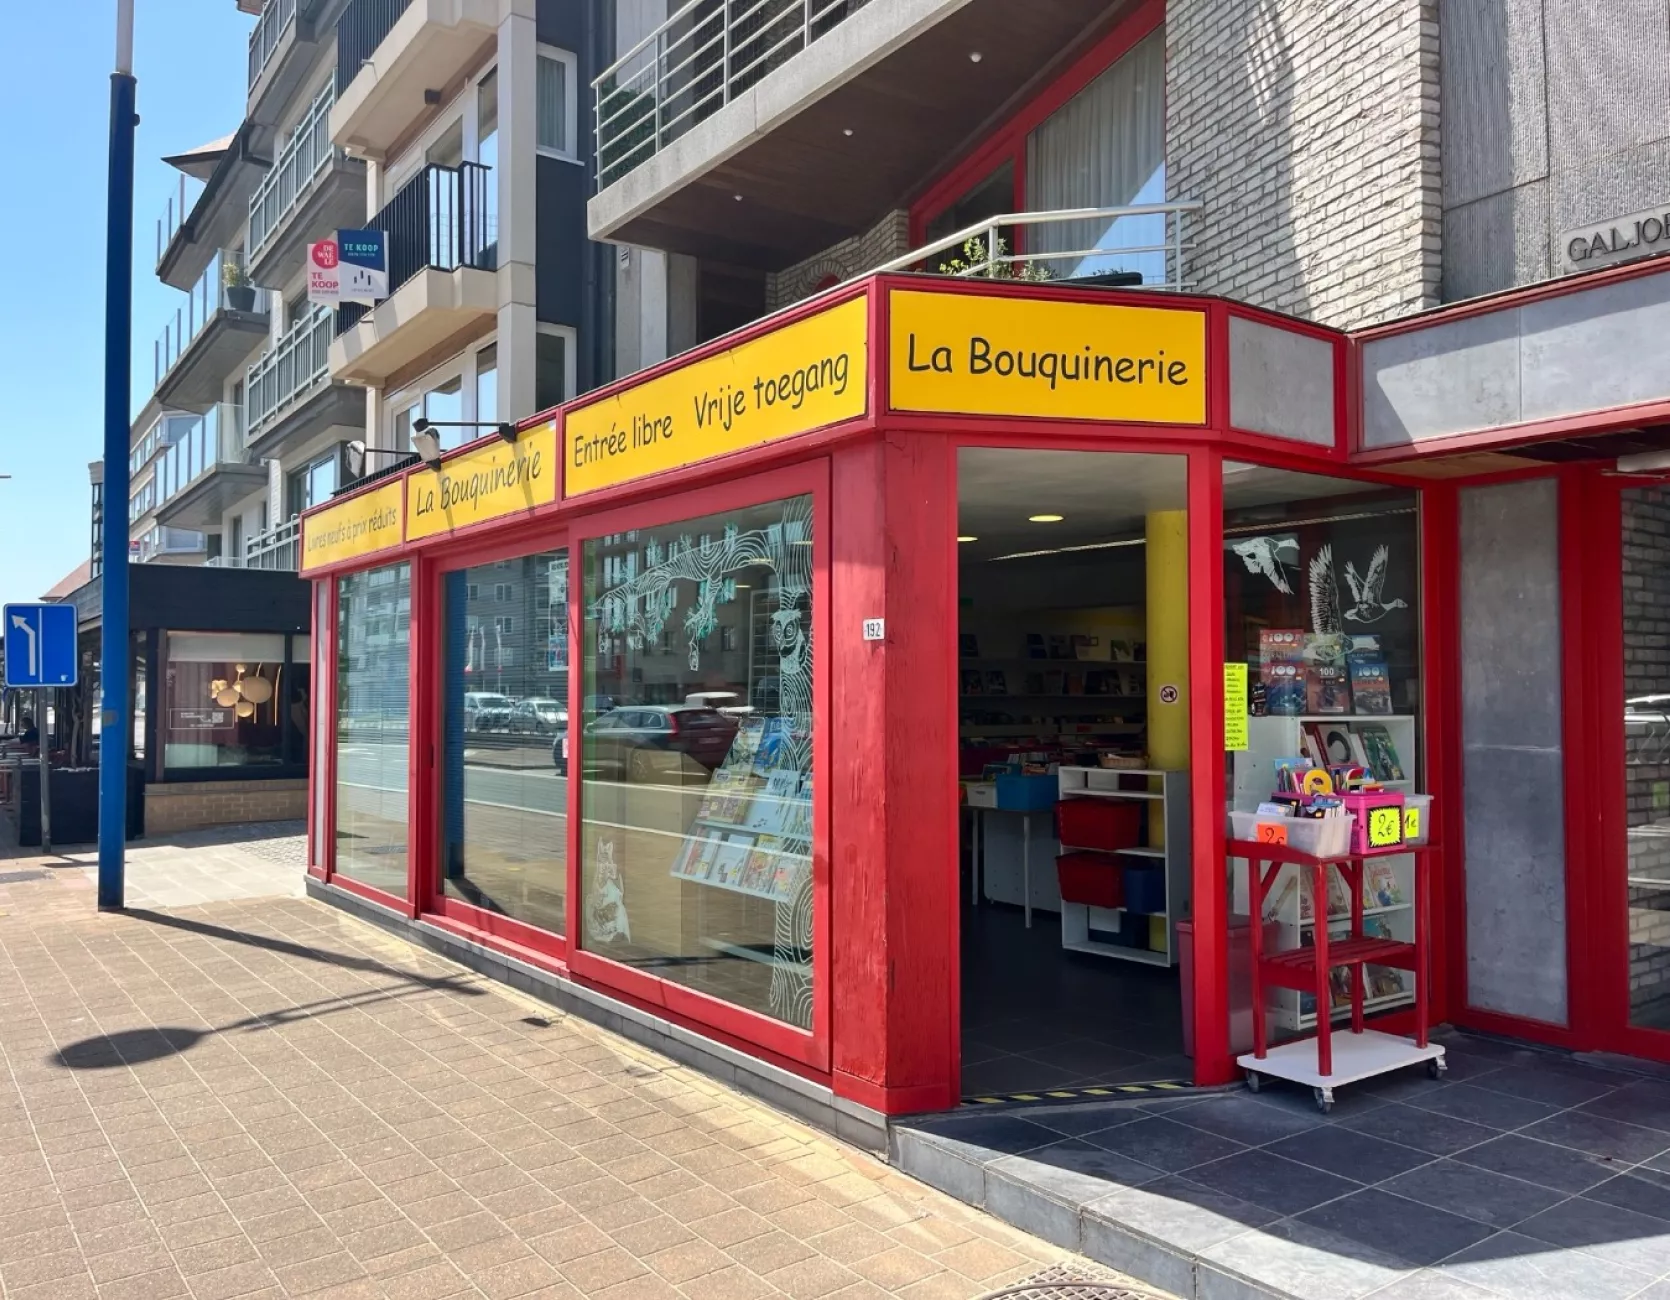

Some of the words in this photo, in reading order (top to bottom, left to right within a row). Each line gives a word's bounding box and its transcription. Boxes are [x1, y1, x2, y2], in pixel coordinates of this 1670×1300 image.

[344, 243, 353, 251] TE
[356, 244, 379, 252] KOOP
[312, 272, 323, 280] TE
[311, 281, 339, 289] KOOP
[908, 333, 953, 373] La
[969, 336, 1189, 390] Bouquinerie
[573, 422, 627, 468] Entrée
[633, 412, 673, 450] libre
[694, 384, 746, 432] Vrije
[753, 353, 849, 411] toegang
[416, 487, 434, 517] La
[440, 441, 542, 512] Bouquinerie
[327, 520, 346, 546] neufs
[352, 514, 368, 545] prix
[368, 507, 397, 534] réduits
[866, 622, 881, 638] 192
[1319, 667, 1335, 677] 100
